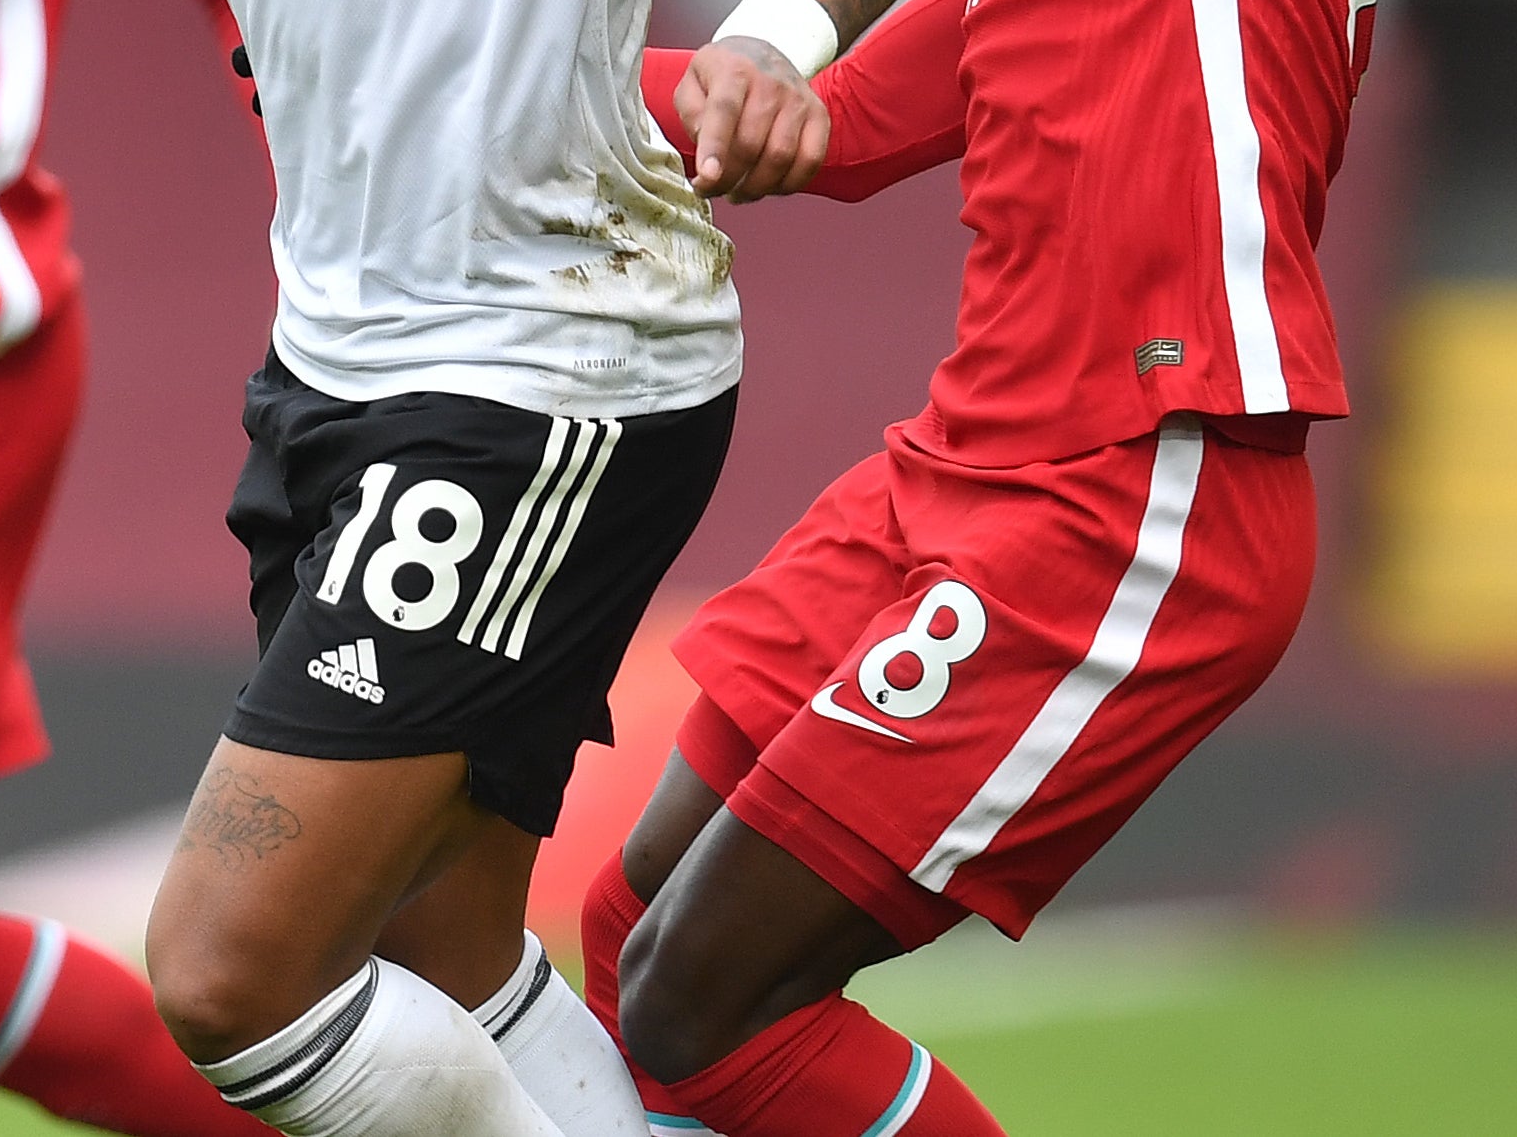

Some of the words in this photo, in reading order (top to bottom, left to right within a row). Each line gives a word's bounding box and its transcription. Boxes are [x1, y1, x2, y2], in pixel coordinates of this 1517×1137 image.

[316, 462, 483, 631] 18
[308, 658, 386, 704] adidas
[858, 578, 988, 719] 8
